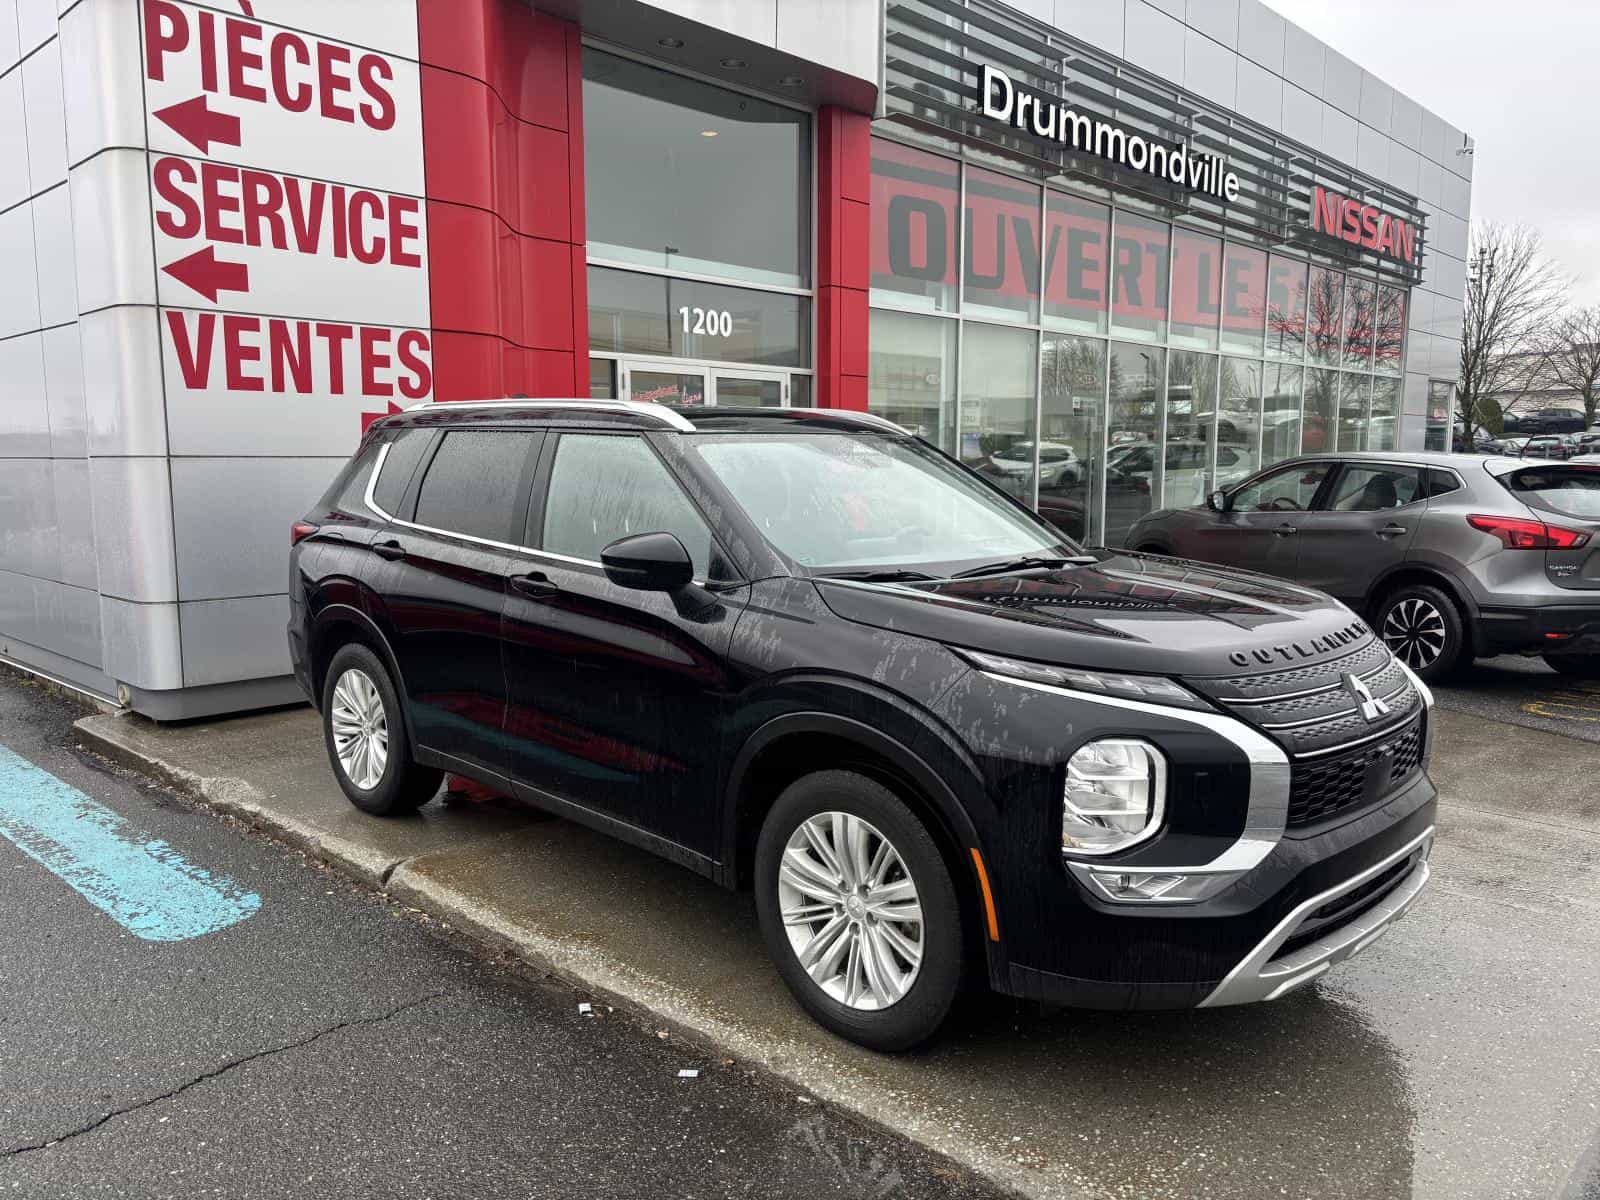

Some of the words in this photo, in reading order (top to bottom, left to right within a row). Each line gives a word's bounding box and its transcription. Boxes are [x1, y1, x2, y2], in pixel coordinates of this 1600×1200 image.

[142, 0, 396, 131] PIÈCES
[982, 64, 1241, 202] Drummondville
[153, 156, 422, 268] SERVICE
[888, 195, 1178, 309] OUVERT
[1311, 184, 1415, 262] NISSAN
[166, 311, 432, 399] VENTES
[679, 306, 732, 337] 1200
